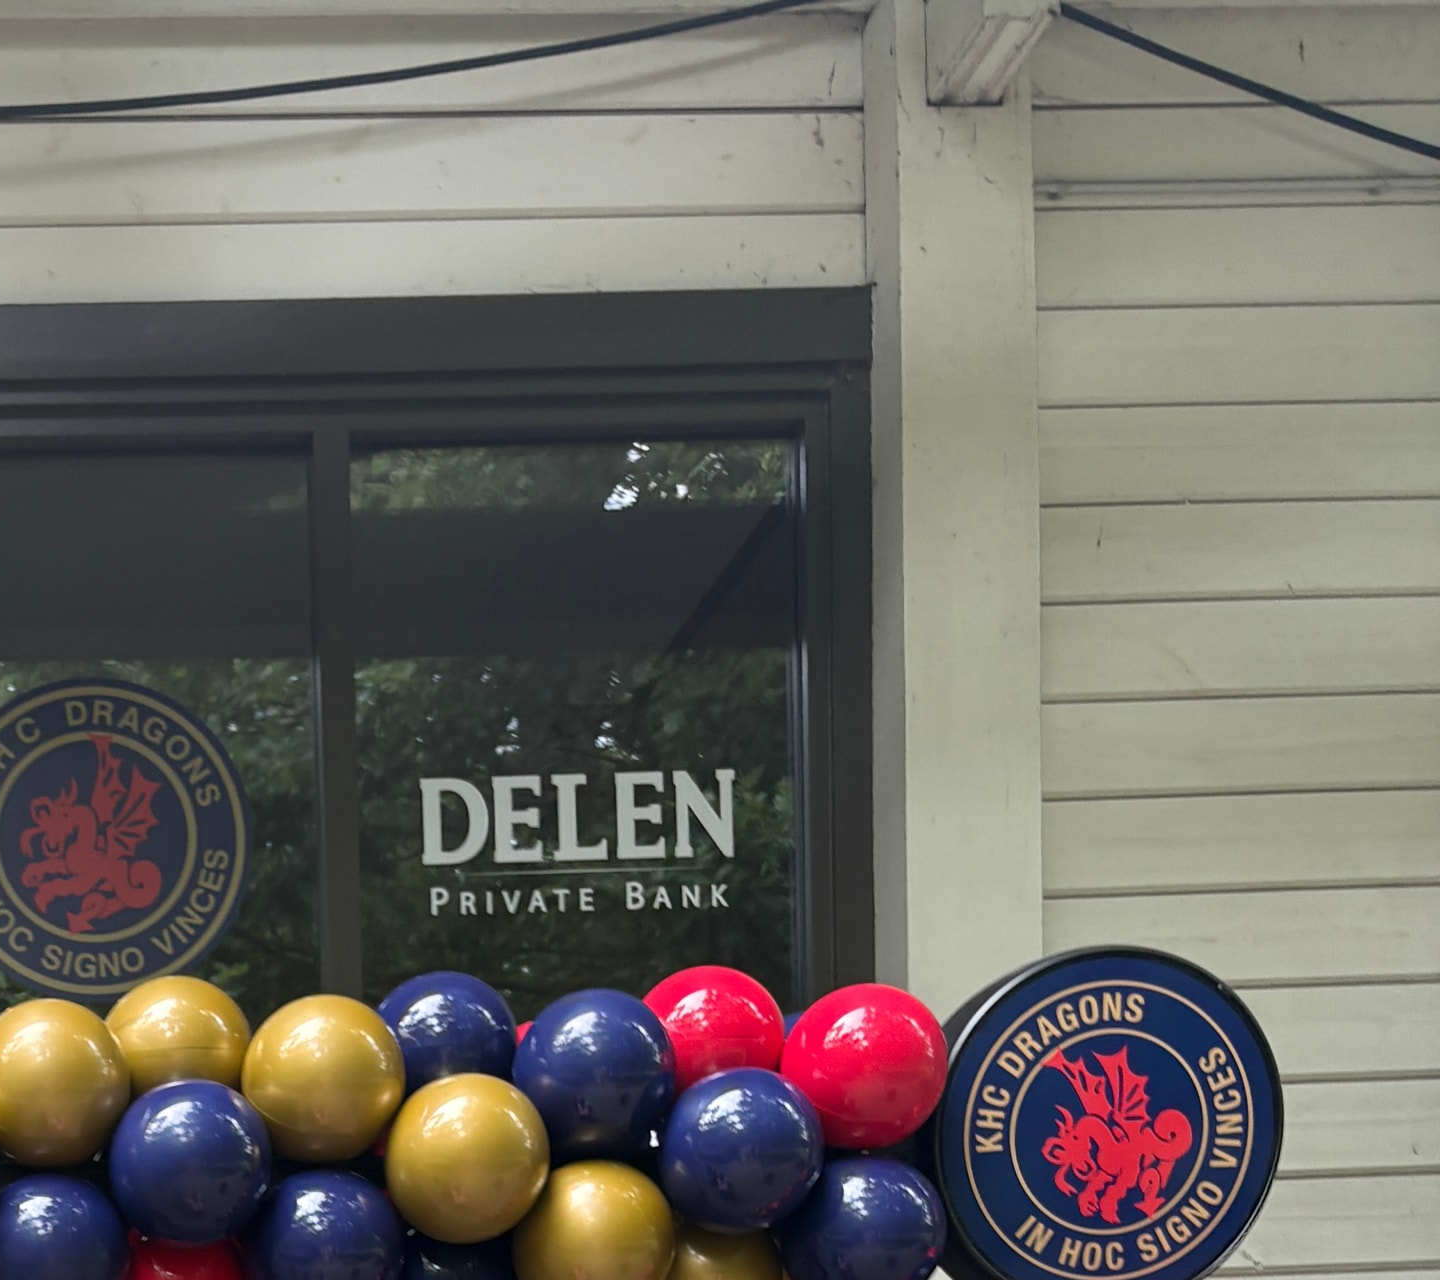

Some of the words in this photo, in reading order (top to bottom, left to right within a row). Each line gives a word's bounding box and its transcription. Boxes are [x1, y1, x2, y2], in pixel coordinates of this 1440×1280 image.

[65, 699, 221, 807] DRAGONS
[419, 768, 735, 866] DELEN
[41, 944, 145, 979] SIGNO
[150, 849, 229, 956] VINCES
[430, 886, 596, 916] PRIVATE
[625, 881, 730, 911] BANK
[974, 1084, 1011, 1153] KHC
[996, 991, 1146, 1079] DRAGONS
[1013, 1215, 1055, 1254] IN
[1057, 1236, 1125, 1272] HOC
[1135, 1179, 1224, 1263] SIGNO
[1198, 1046, 1244, 1169] VINCES
